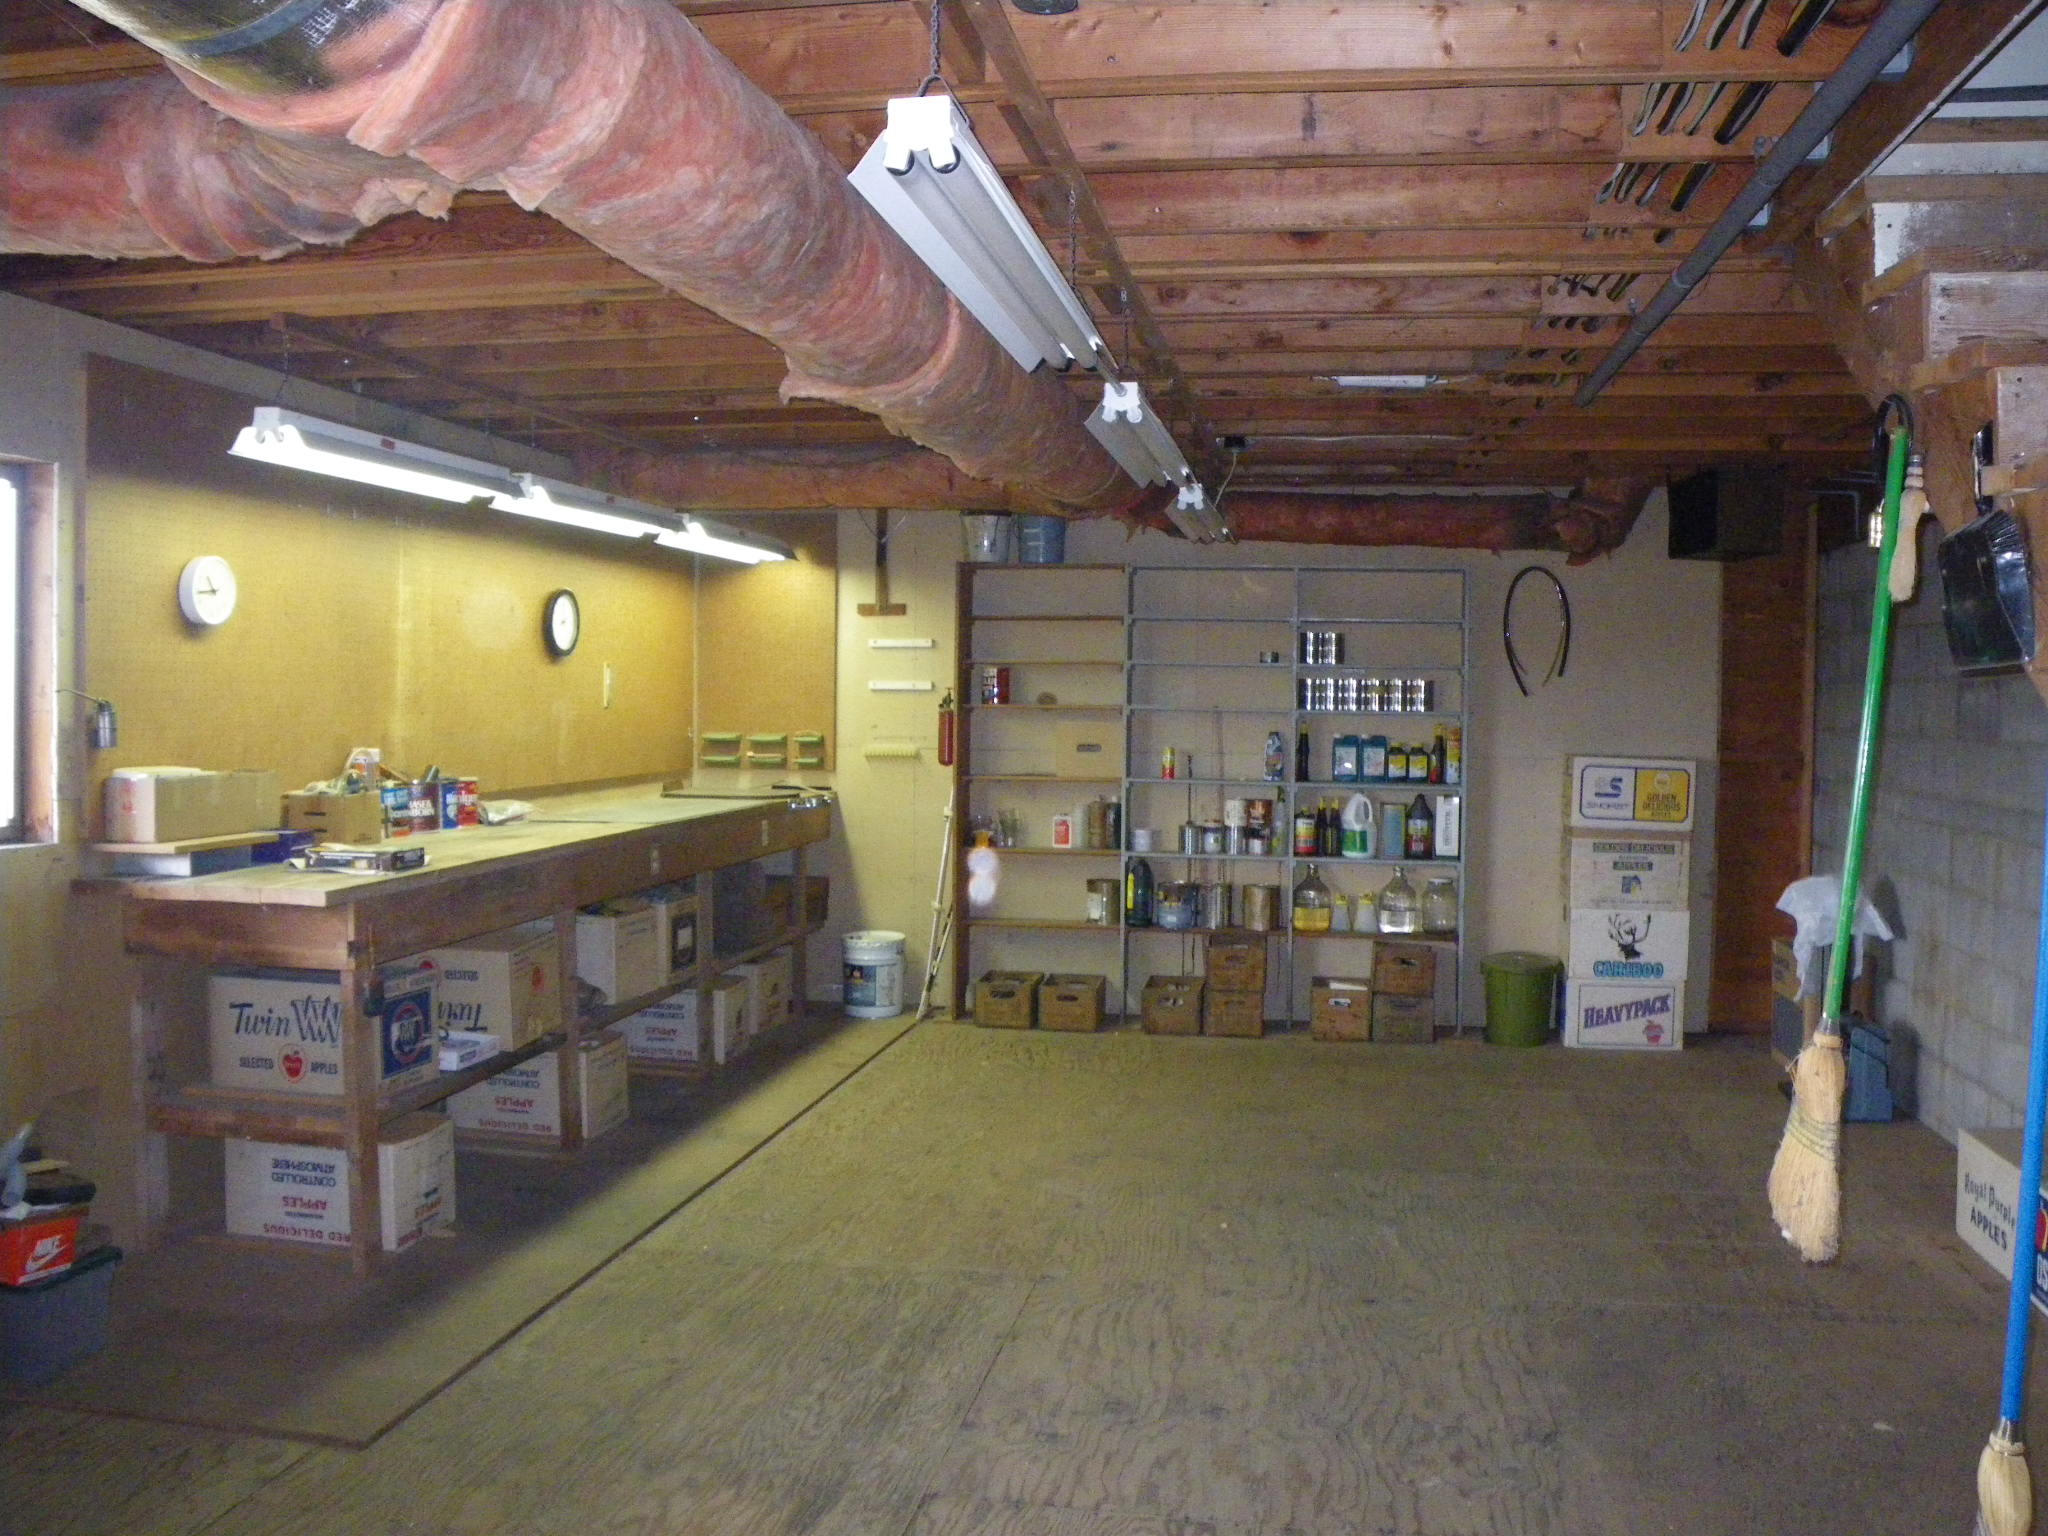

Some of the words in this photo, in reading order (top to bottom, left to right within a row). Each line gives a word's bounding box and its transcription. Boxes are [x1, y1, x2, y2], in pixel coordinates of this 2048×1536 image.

[1593, 960, 1664, 979] CARIBOO
[229, 1001, 291, 1036] Twin
[1584, 993, 1672, 1030] HEAVYPACK
[310, 1061, 338, 1075] APPLES
[493, 1096, 535, 1108] APPLES
[272, 1158, 336, 1174] ATMOSPHERE
[271, 1171, 337, 1188] CONTROLLED
[1965, 1172, 1987, 1201] Royal
[282, 1195, 327, 1210] APPLES
[263, 1223, 324, 1240] DELICIOUS
[1970, 1205, 2008, 1251] APPLES
